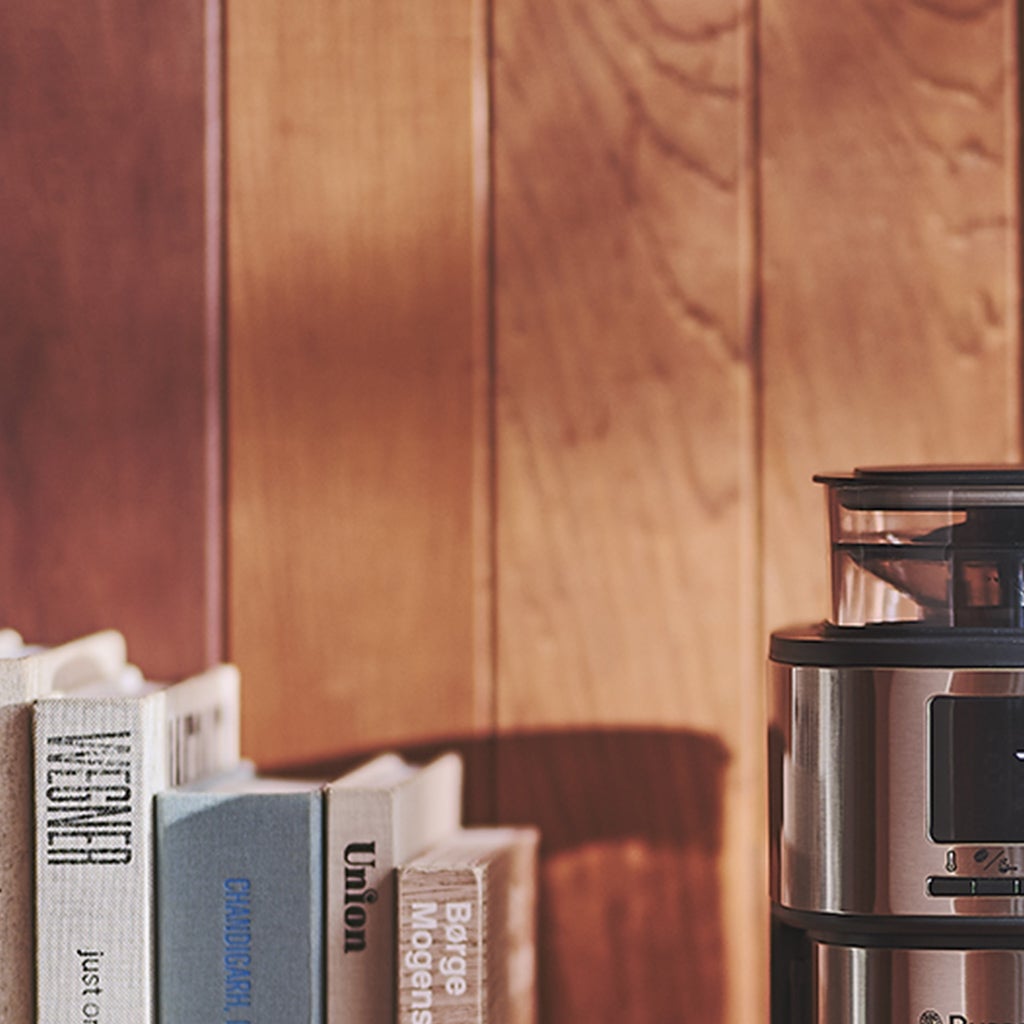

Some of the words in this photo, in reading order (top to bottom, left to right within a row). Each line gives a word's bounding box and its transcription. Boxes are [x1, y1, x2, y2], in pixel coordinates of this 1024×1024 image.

[47, 731, 131, 864] WEGNER
[224, 878, 251, 1012] CHANDIGARH,
[344, 841, 377, 953] Union
[439, 902, 471, 996] Børge
[77, 949, 104, 995] just
